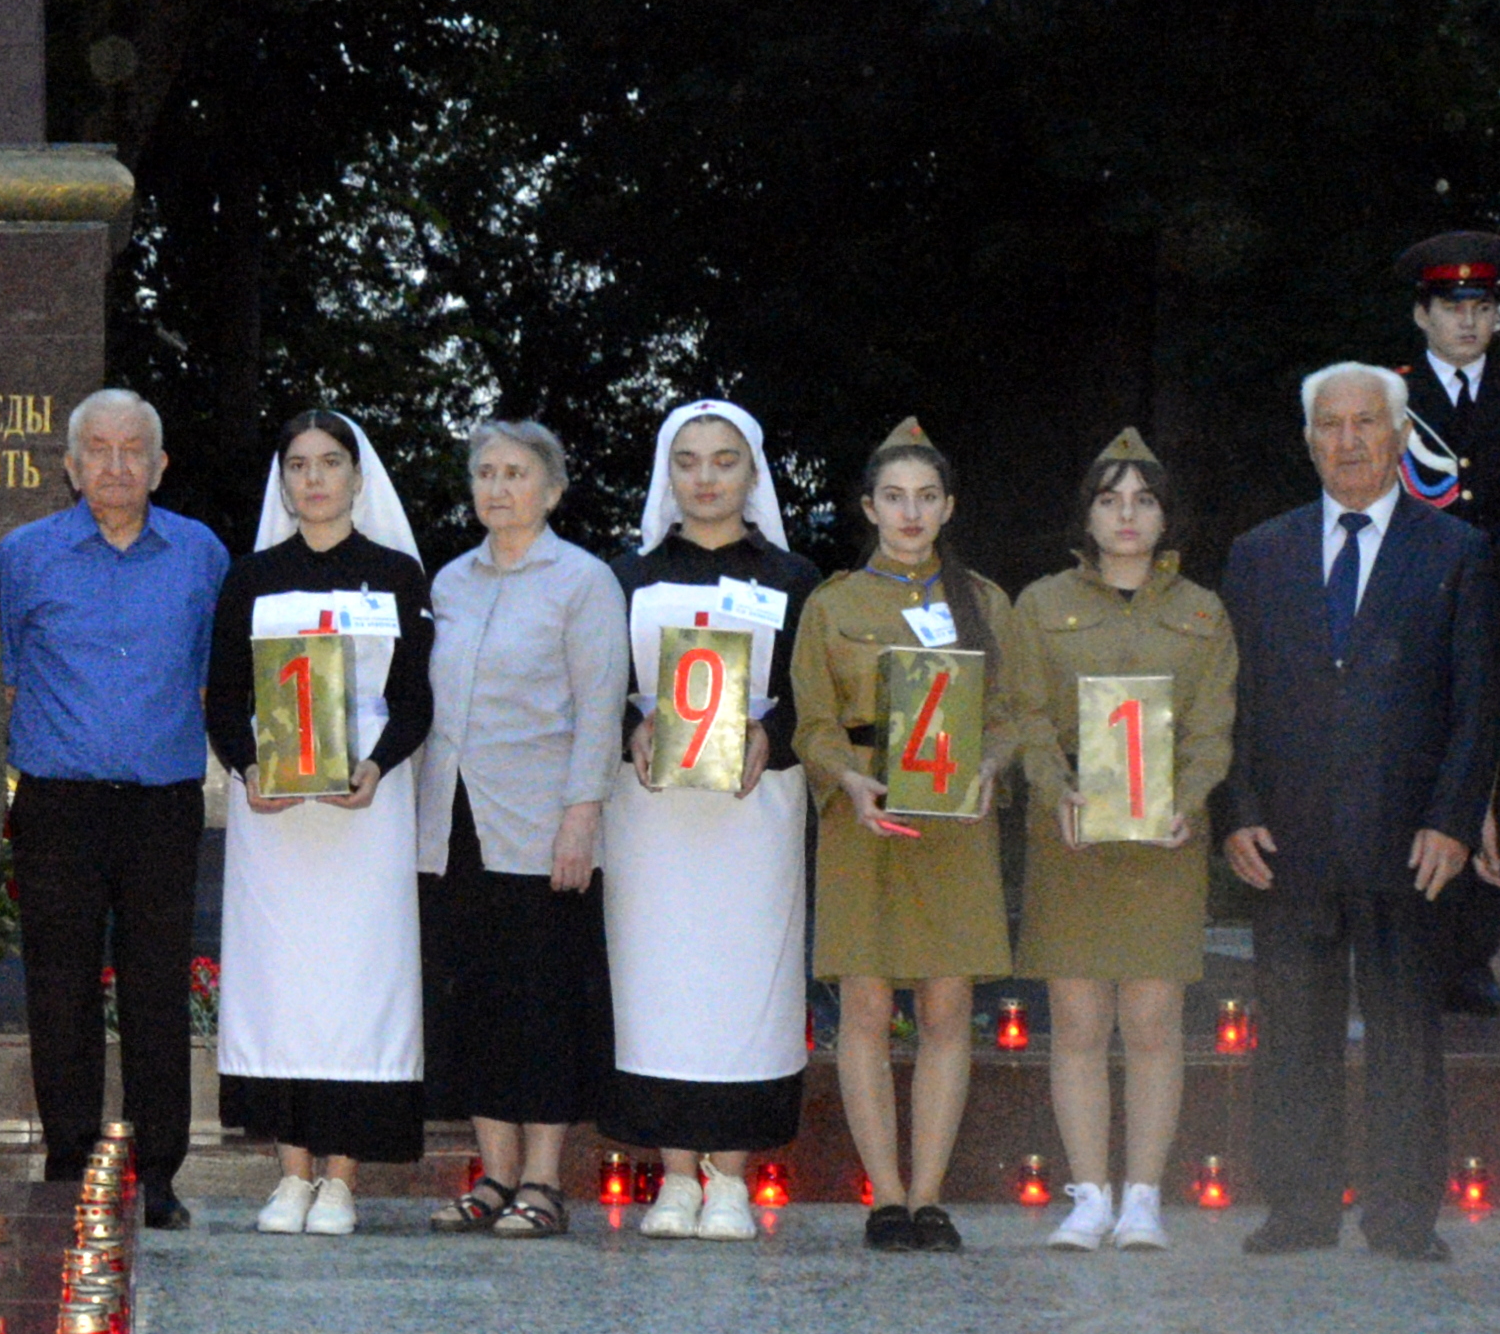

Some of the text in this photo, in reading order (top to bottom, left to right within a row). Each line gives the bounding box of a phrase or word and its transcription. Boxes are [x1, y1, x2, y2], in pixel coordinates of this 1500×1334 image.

[278, 656, 317, 776] 1
[673, 647, 726, 770] 9
[901, 672, 959, 794] 4
[1110, 699, 1144, 820] 1
